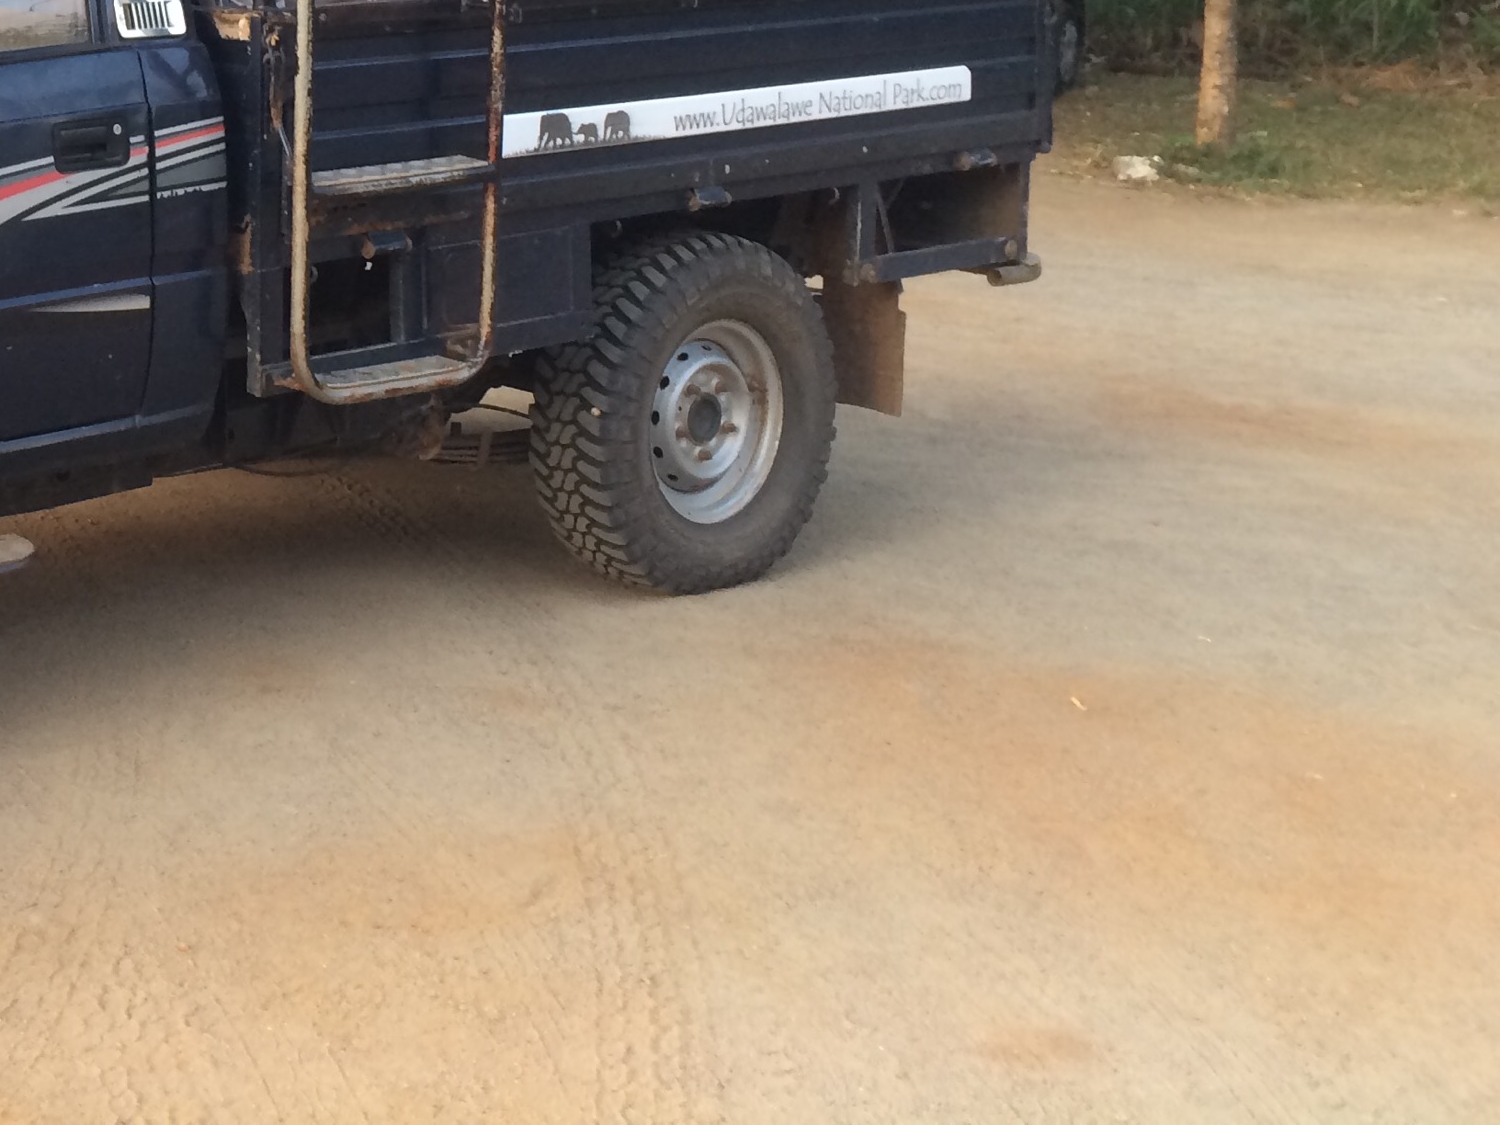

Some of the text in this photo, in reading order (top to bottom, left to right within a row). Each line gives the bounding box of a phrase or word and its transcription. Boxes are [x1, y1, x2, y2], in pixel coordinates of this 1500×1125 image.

[673, 76, 963, 132] www.Udawalawe National Park.com
